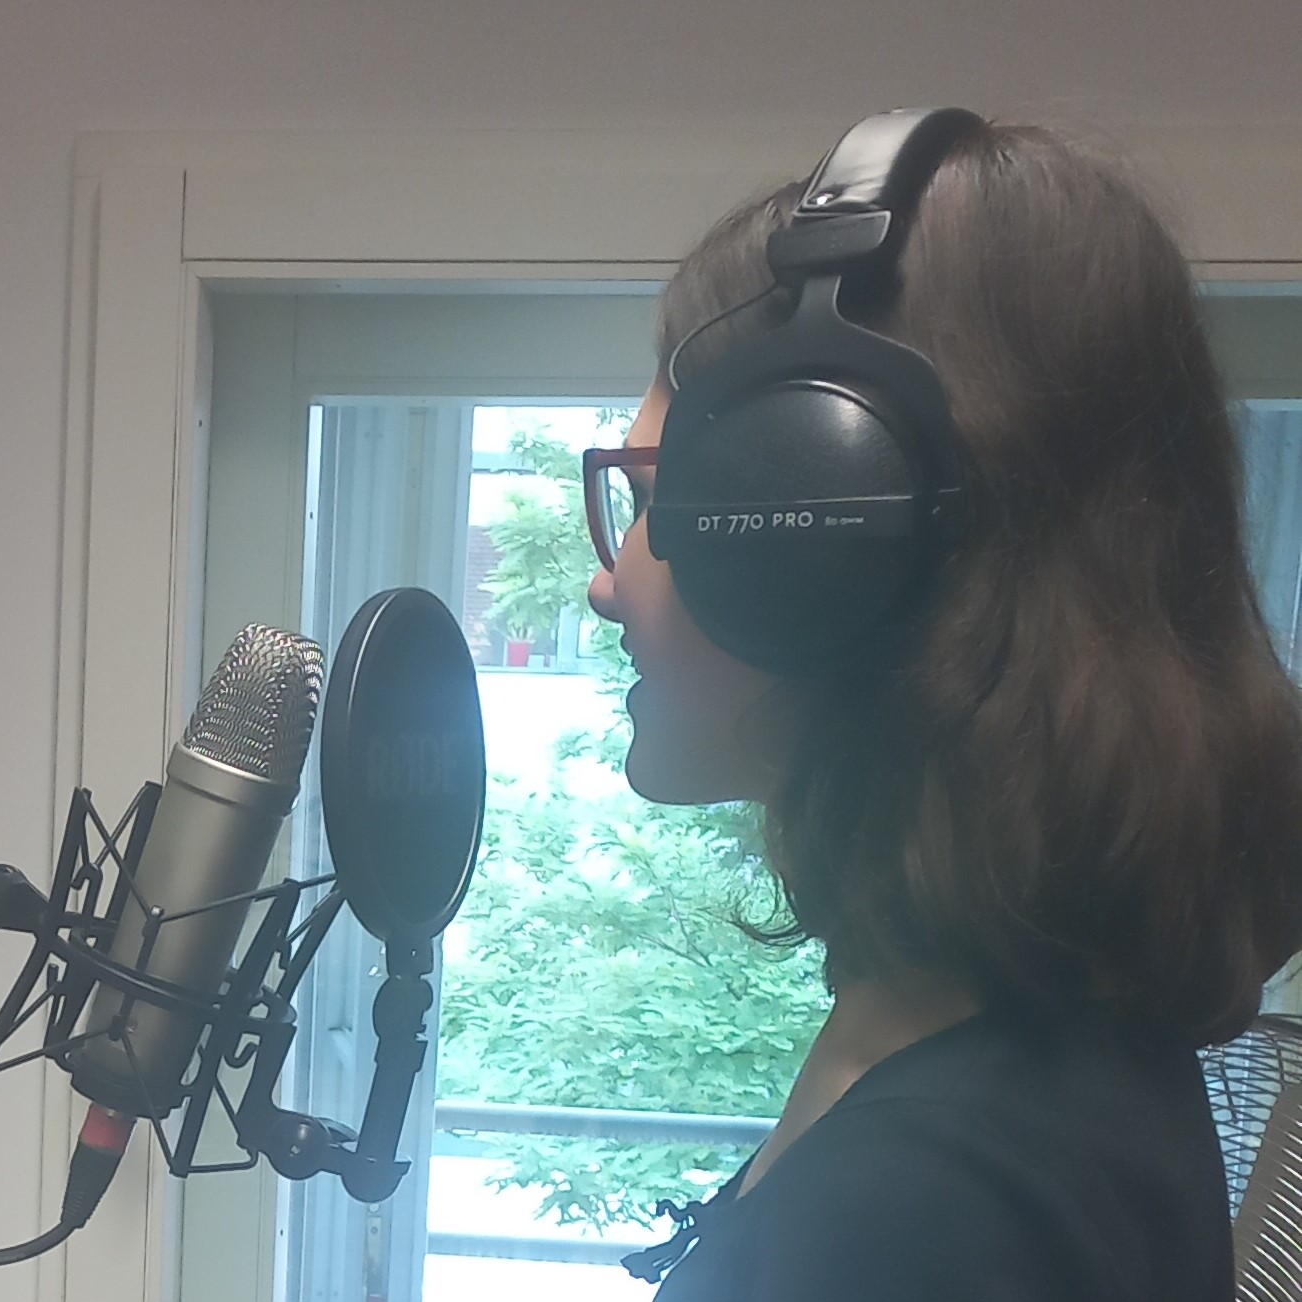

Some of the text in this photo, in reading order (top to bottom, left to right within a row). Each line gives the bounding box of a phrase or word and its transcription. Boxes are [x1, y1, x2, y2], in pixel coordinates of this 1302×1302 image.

[698, 515, 722, 532] DT
[727, 513, 765, 535] 770
[771, 510, 814, 528] PRO
